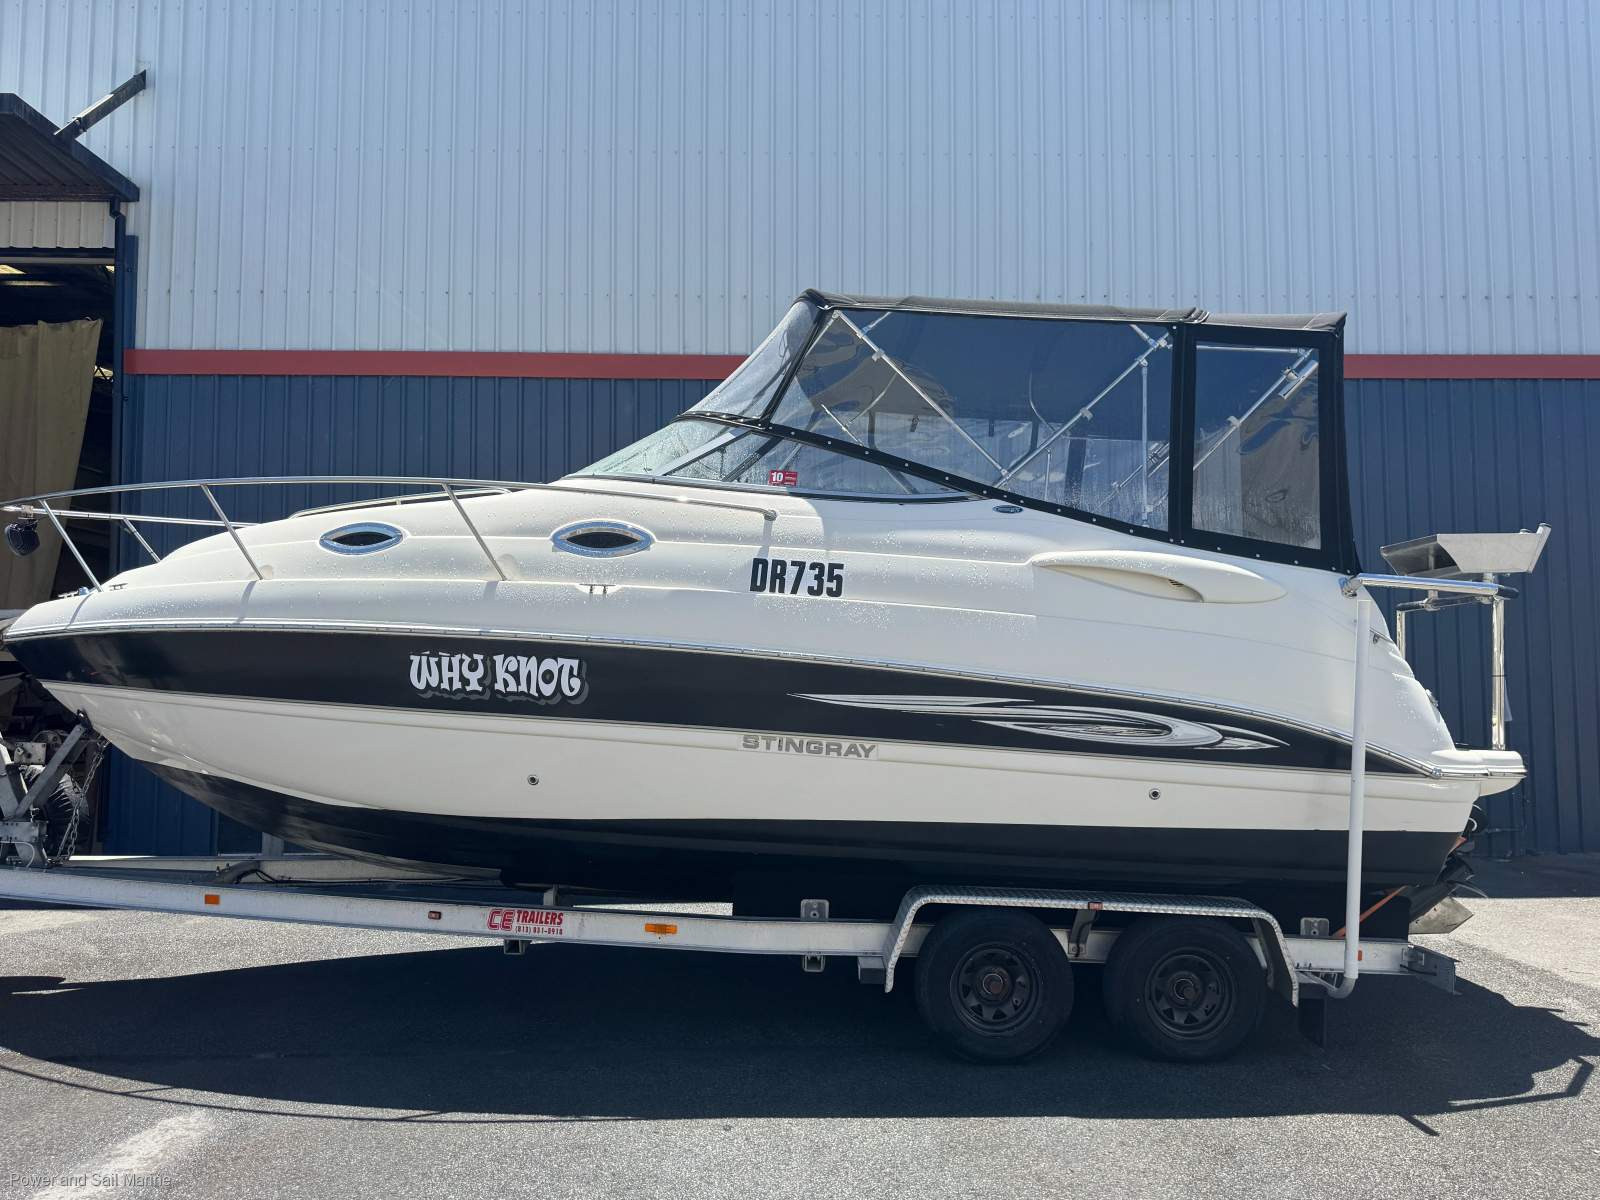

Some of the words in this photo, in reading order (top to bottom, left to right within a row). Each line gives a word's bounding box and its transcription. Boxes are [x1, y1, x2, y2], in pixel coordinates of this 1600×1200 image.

[771, 471, 784, 482] 10
[750, 557, 844, 598] DR735
[410, 651, 485, 692] WHY
[493, 653, 582, 697] KNOT
[742, 734, 876, 759] STINGRAY
[487, 908, 515, 932] CE
[516, 909, 564, 926] TRAILERS
